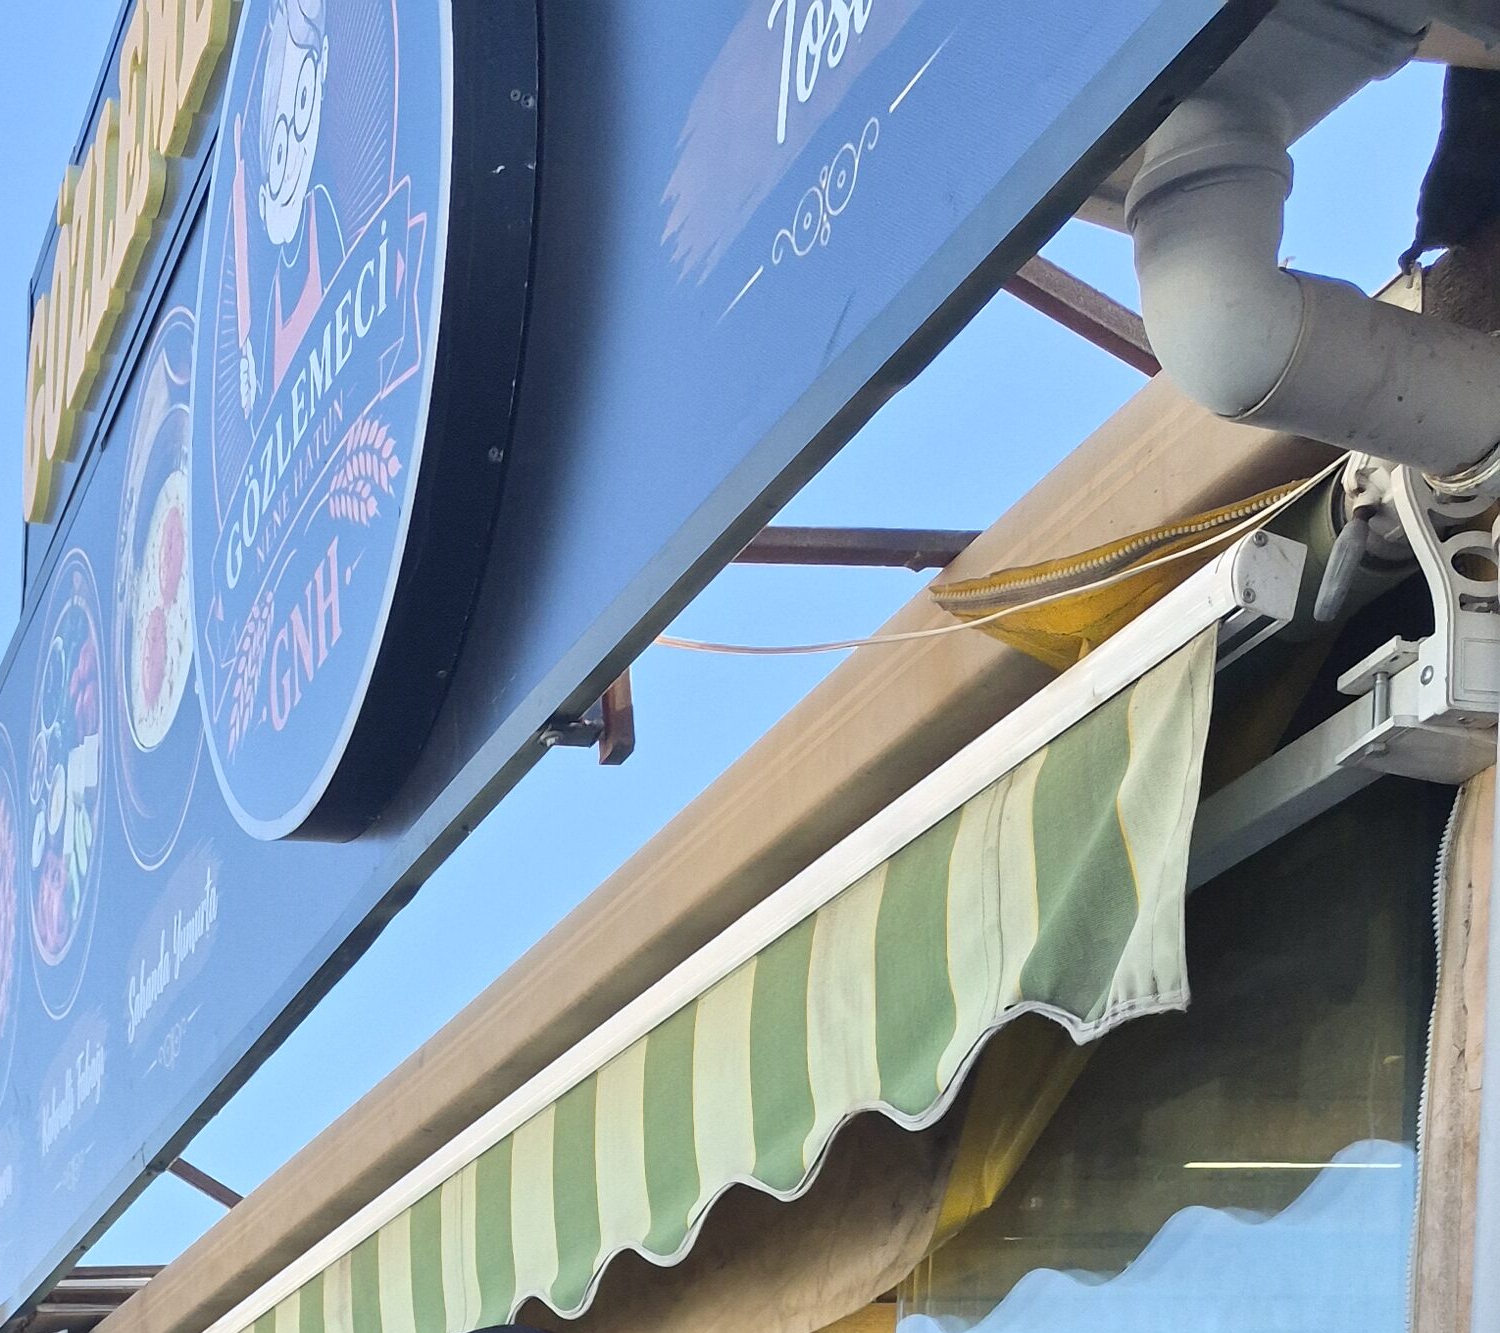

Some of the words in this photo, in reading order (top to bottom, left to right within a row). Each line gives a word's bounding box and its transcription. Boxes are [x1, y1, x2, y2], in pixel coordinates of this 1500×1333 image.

[226, 219, 388, 589] GÖZLEMECİ
[294, 388, 344, 498] HATUN
[269, 535, 342, 732] GNH
[173, 866, 219, 980] Yumurta
